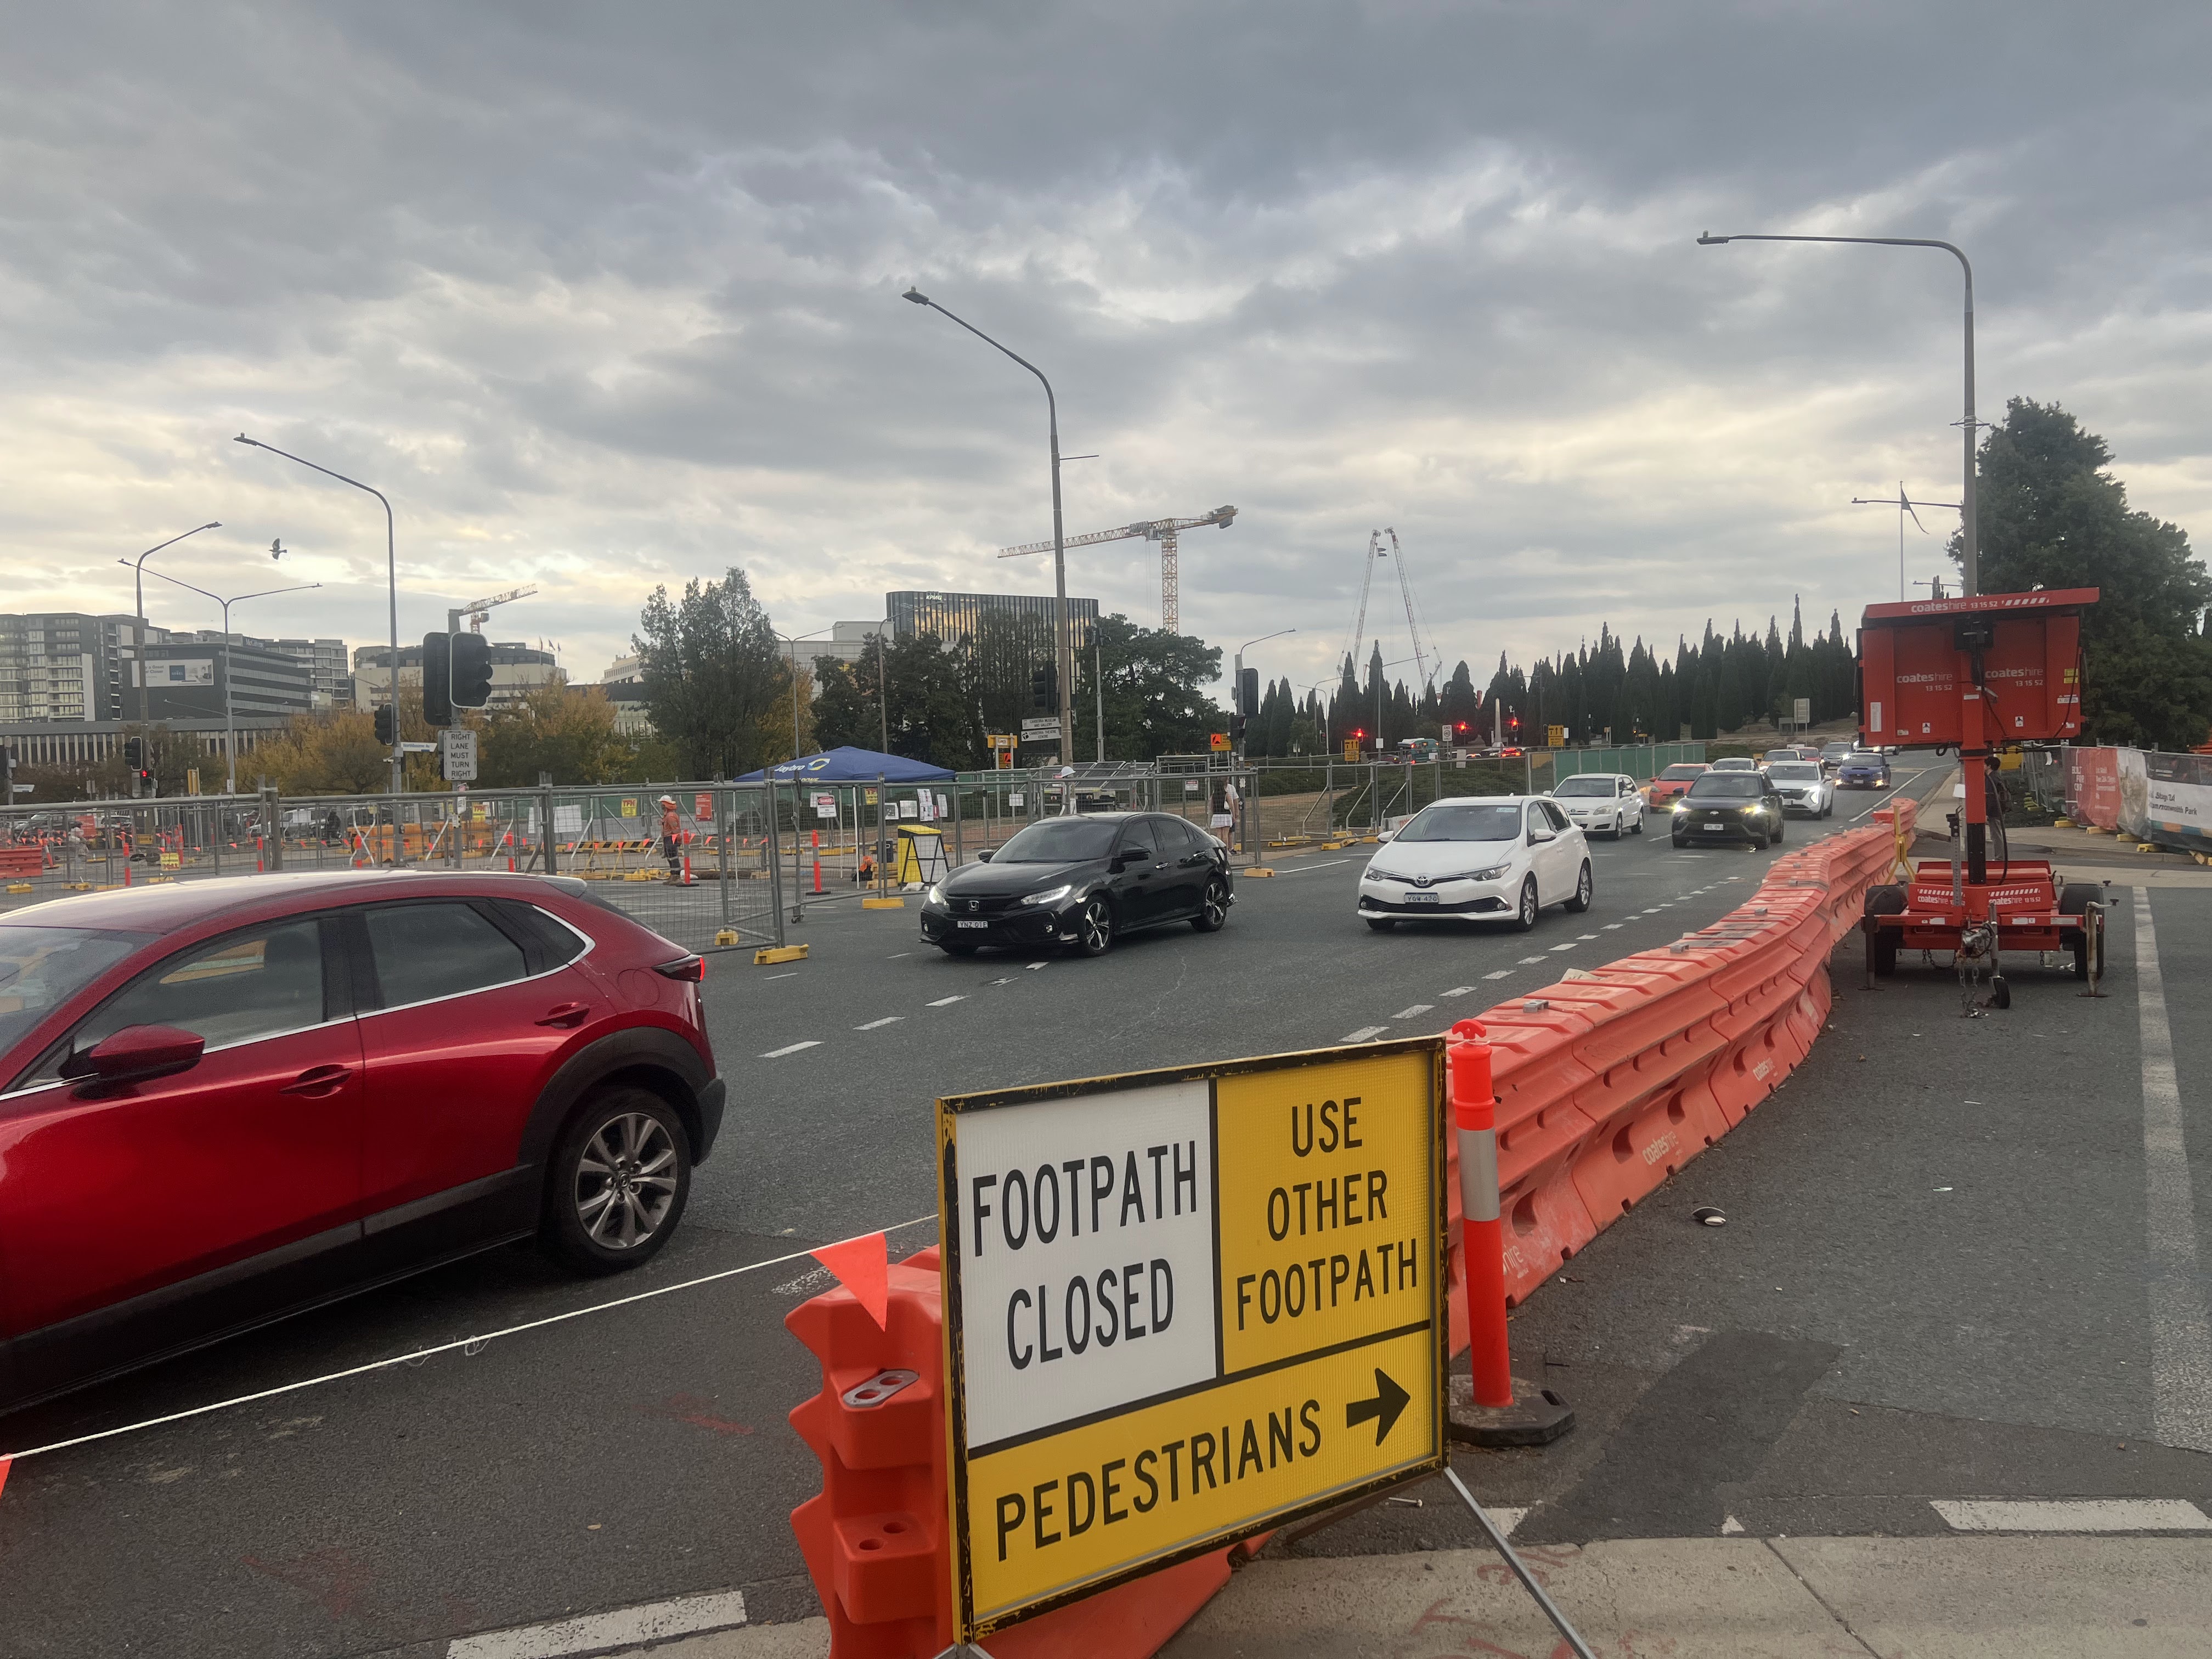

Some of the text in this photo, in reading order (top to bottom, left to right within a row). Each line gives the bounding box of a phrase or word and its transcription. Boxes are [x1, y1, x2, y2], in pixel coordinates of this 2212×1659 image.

[1911, 601, 1967, 613] coateshire
[1897, 672, 1953, 684] coateshire
[774, 765, 805, 774] Jaybro
[2185, 807, 2197, 815] Park
[1293, 1097, 1362, 1157] USE
[973, 1141, 1196, 1256] FOOTPATH
[1268, 1170, 1387, 1241] OTHER
[1008, 1259, 1173, 1369] CLOSED
[1237, 1239, 1416, 1330] FOOTPATH
[997, 1400, 1321, 1561] PEDESTRIANS
